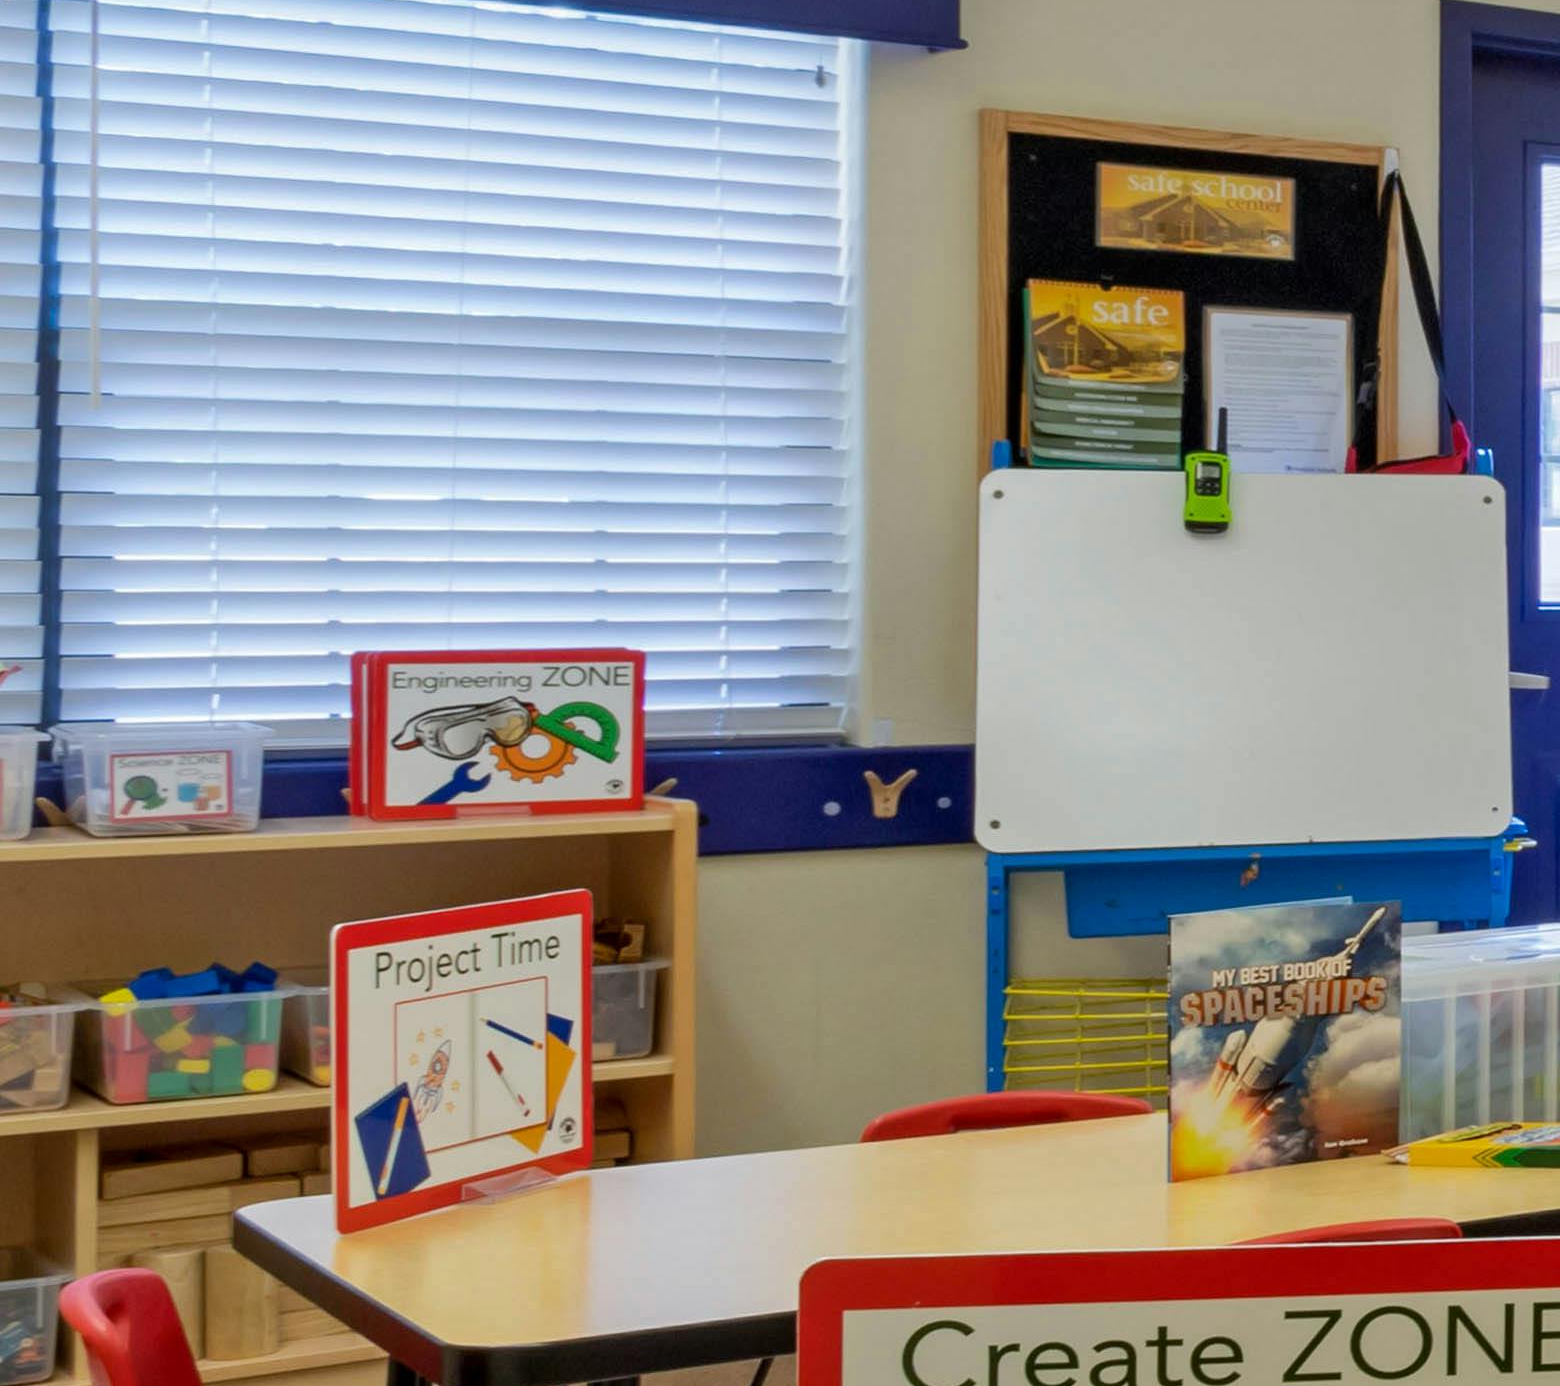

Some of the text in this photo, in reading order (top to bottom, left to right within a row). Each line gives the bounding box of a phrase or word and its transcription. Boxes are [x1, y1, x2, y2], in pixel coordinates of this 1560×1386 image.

[1128, 173, 1282, 202] safe school
[1226, 199, 1280, 213] center
[1092, 296, 1169, 326] safe
[392, 666, 631, 694] Engineering ZONE
[374, 931, 562, 993] Project Time
[1212, 959, 1352, 988] MY BEST BOOK OF
[1180, 977, 1387, 1027] SPACESHIPS
